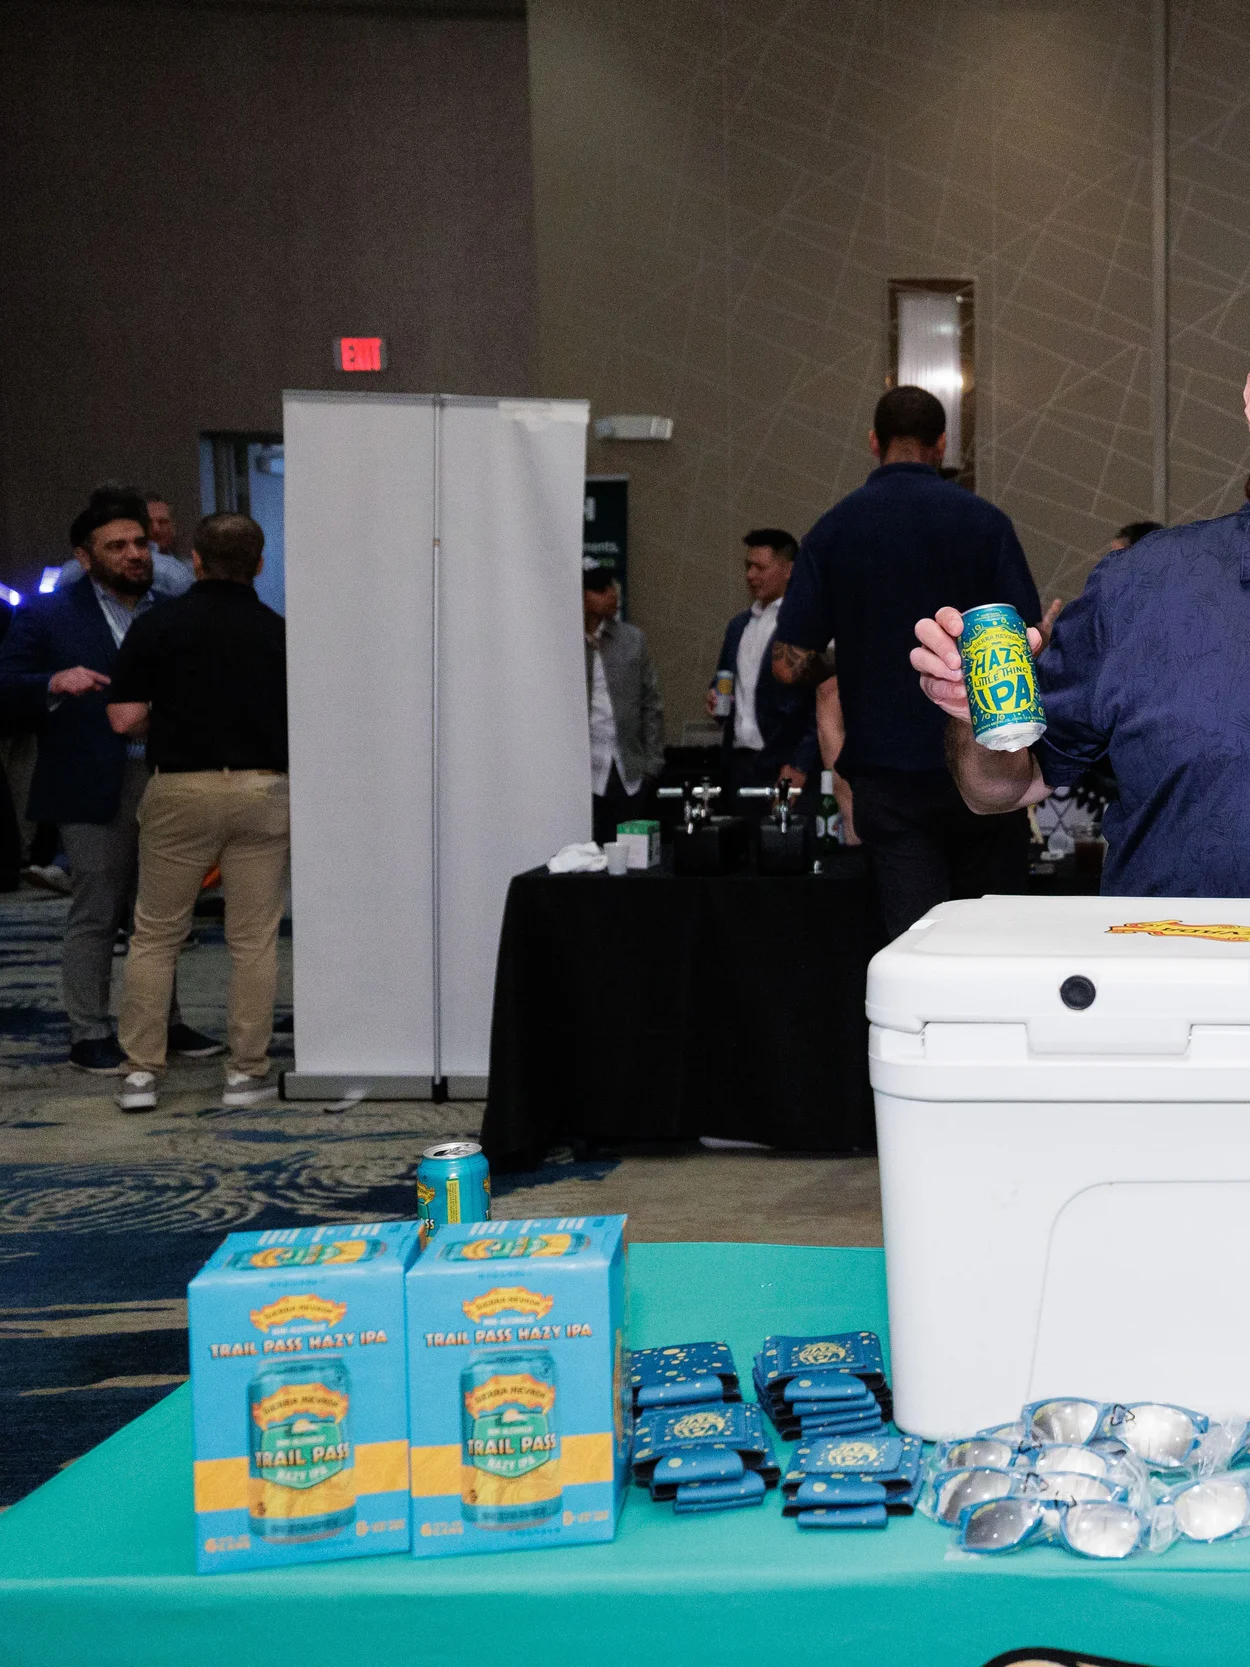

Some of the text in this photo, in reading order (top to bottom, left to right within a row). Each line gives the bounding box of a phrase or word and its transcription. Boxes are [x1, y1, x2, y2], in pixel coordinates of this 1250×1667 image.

[973, 634, 994, 649] SIERRA
[975, 648, 1024, 676] HAZY
[974, 664, 1029, 688] LITTLE THING
[976, 674, 1031, 711] IPA
[210, 1329, 388, 1359] TRAIL PASS HAZY IPA
[425, 1323, 593, 1347] TRAIL PASS HAZY IPA
[254, 1442, 350, 1469] TRAIL PASS
[467, 1432, 557, 1456] TRAIL PASS
[486, 1458, 516, 1471] HAZY
